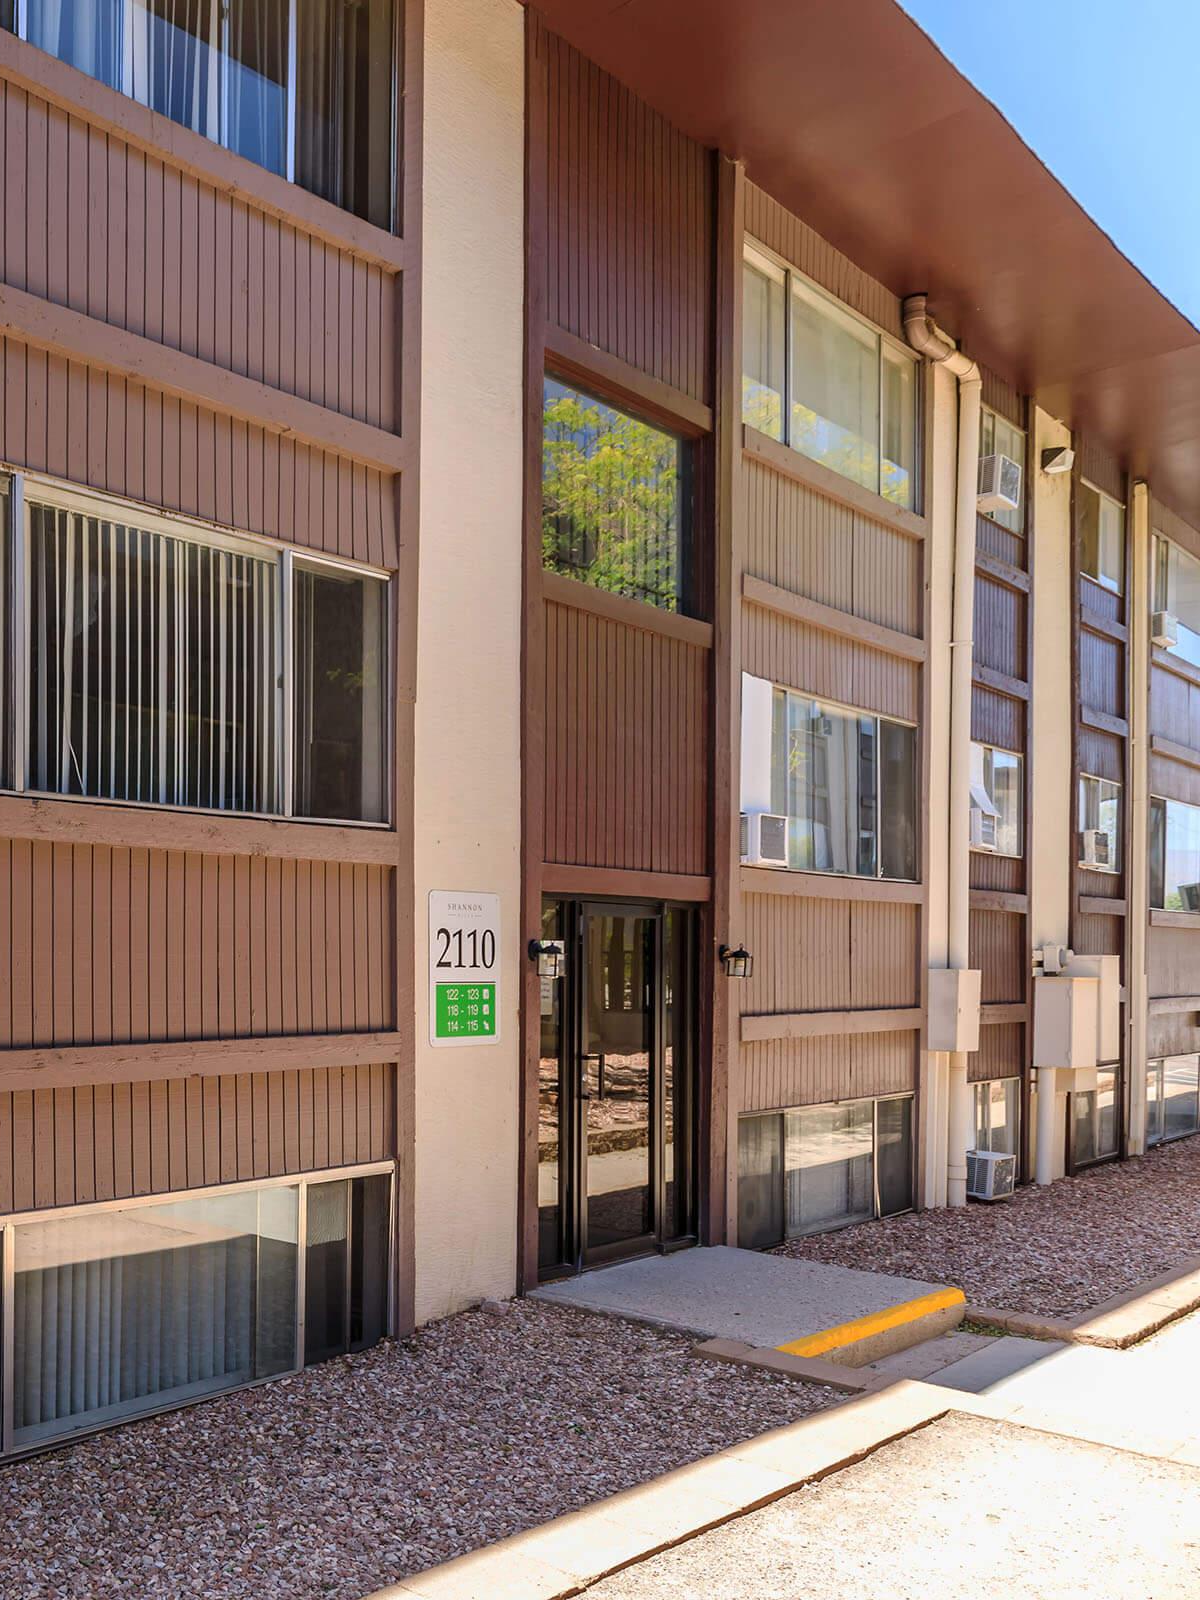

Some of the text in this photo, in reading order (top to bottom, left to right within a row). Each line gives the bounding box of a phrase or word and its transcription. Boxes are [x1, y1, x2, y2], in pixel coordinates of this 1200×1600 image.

[436, 928, 496, 969] 2110
[446, 989, 459, 1001] 122
[467, 989, 480, 1000] 123
[467, 1004, 479, 1016] 119
[447, 1020, 459, 1033] 114
[467, 1020, 479, 1032] 115
